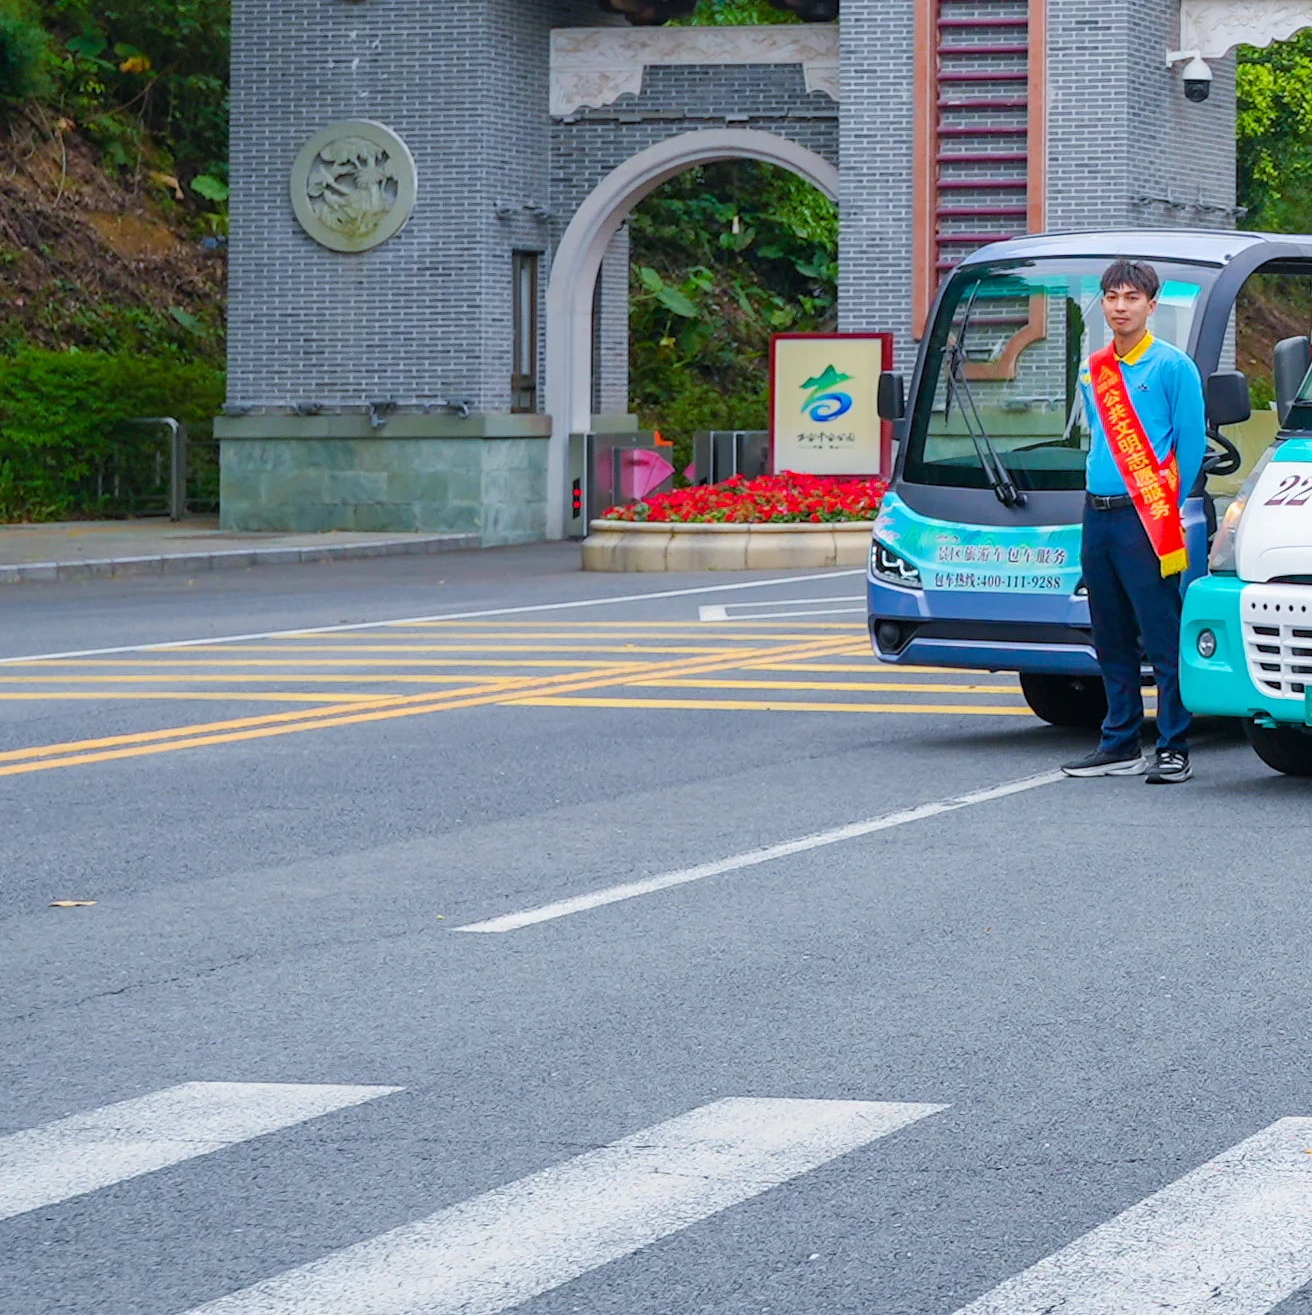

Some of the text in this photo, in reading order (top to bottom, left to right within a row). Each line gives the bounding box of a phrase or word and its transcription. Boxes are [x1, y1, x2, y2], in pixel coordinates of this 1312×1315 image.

[1102, 388, 1171, 521] 公共文明志愿服务
[937, 546, 1067, 566] 景区旅游车包车服务
